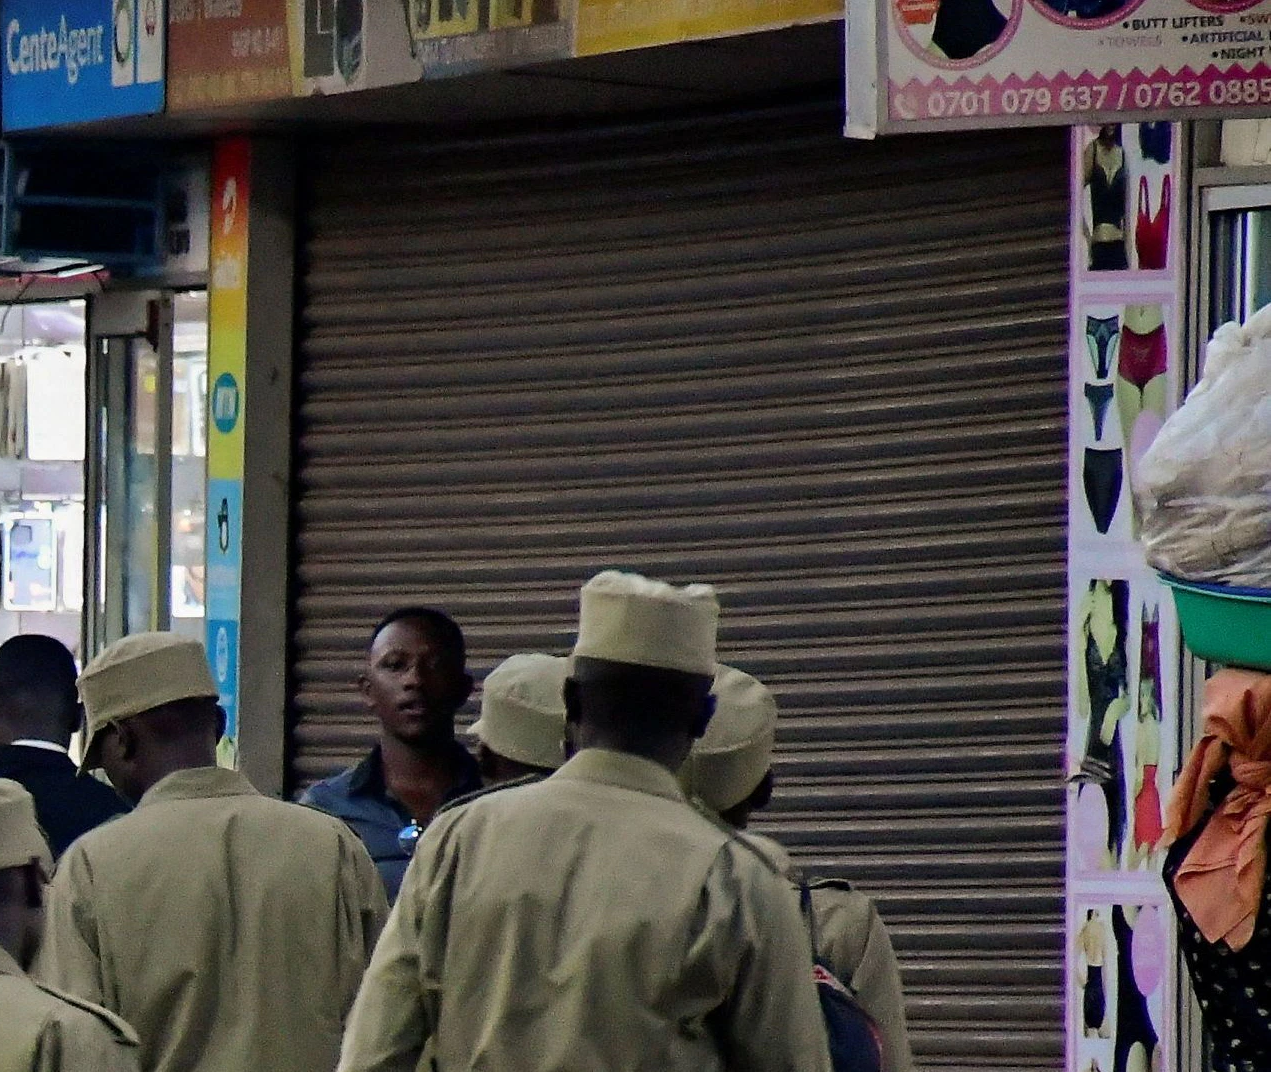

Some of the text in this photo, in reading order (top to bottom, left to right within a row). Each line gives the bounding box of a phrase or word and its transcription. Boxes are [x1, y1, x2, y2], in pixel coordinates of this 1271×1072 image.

[1132, 15, 1225, 30] BUTT LIFTERS
[1190, 30, 1264, 44] ARTIFICIAL
[7, 14, 104, 86] CenteAgent
[1220, 46, 1265, 60] NIGHT
[928, 89, 991, 117] 0701
[1001, 86, 1051, 112] 079
[1059, 83, 1109, 111] 637
[1135, 81, 1201, 108] 0762
